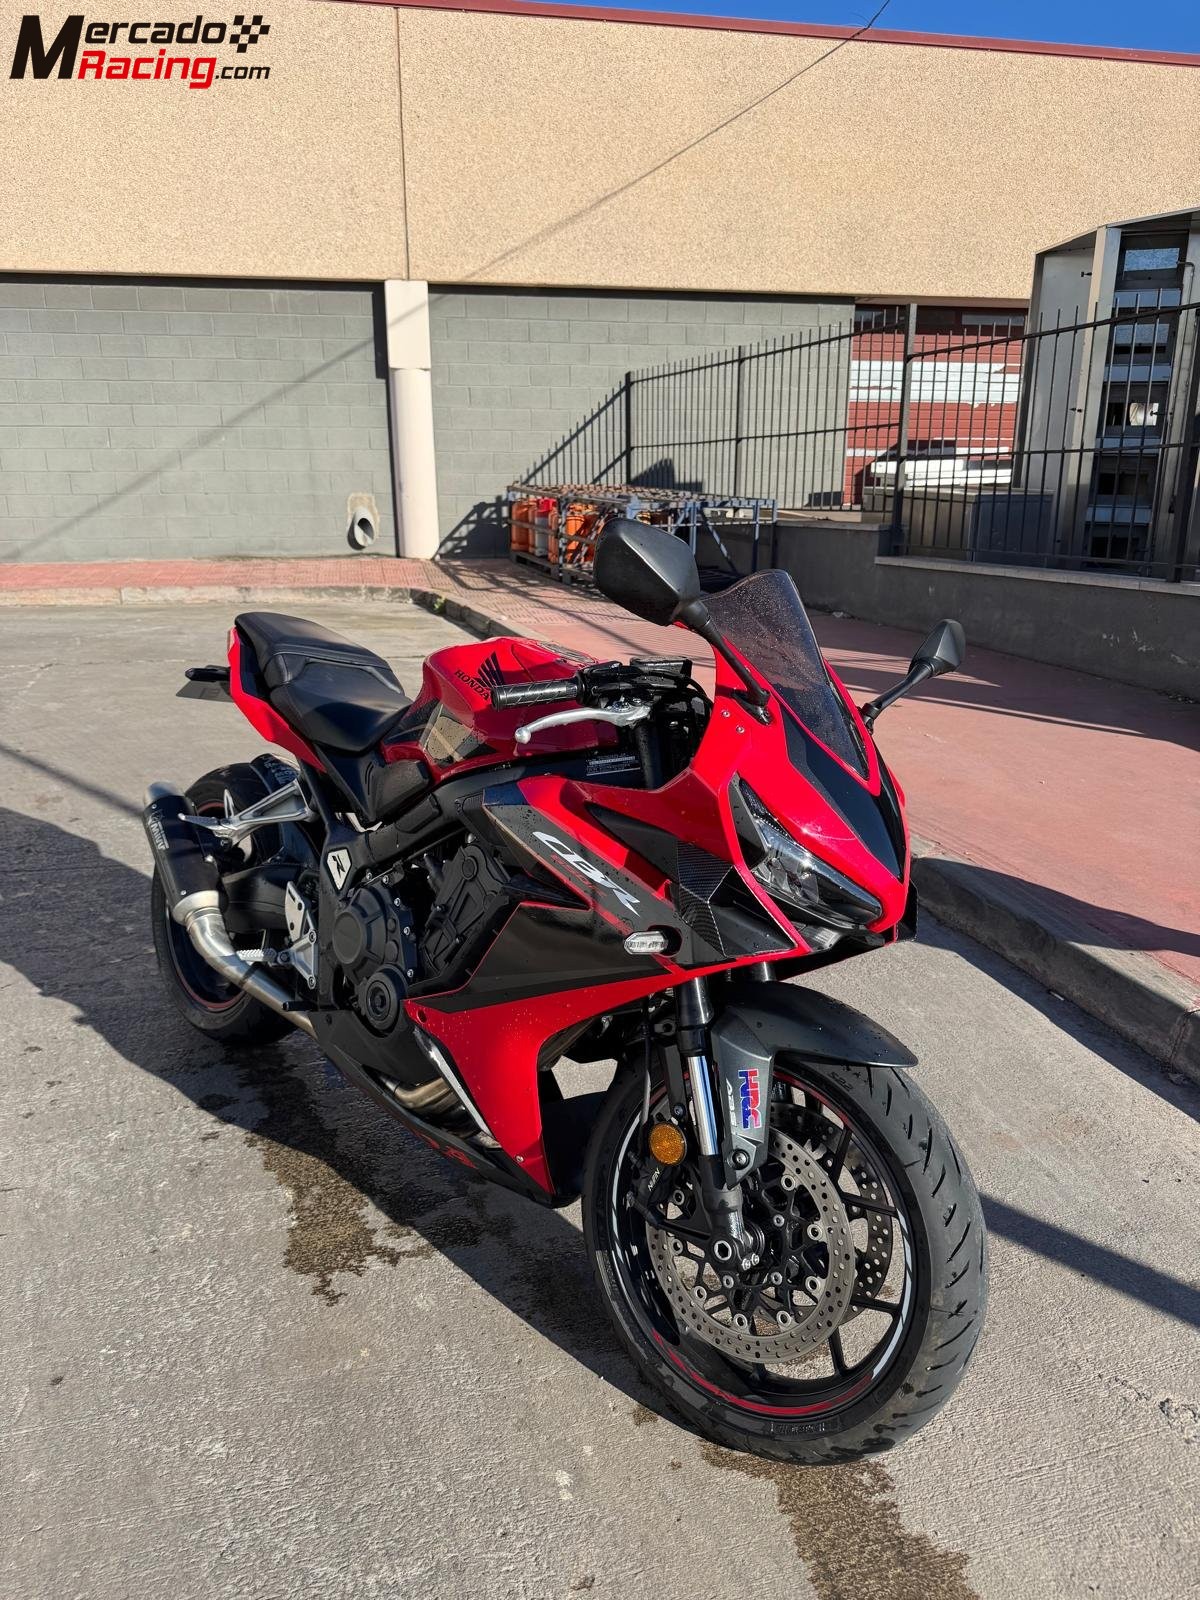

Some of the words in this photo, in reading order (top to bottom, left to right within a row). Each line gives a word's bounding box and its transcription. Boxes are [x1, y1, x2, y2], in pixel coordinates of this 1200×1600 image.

[454, 669, 490, 701] HONDA
[532, 831, 641, 918] CBR
[737, 1068, 762, 1131] HRC
